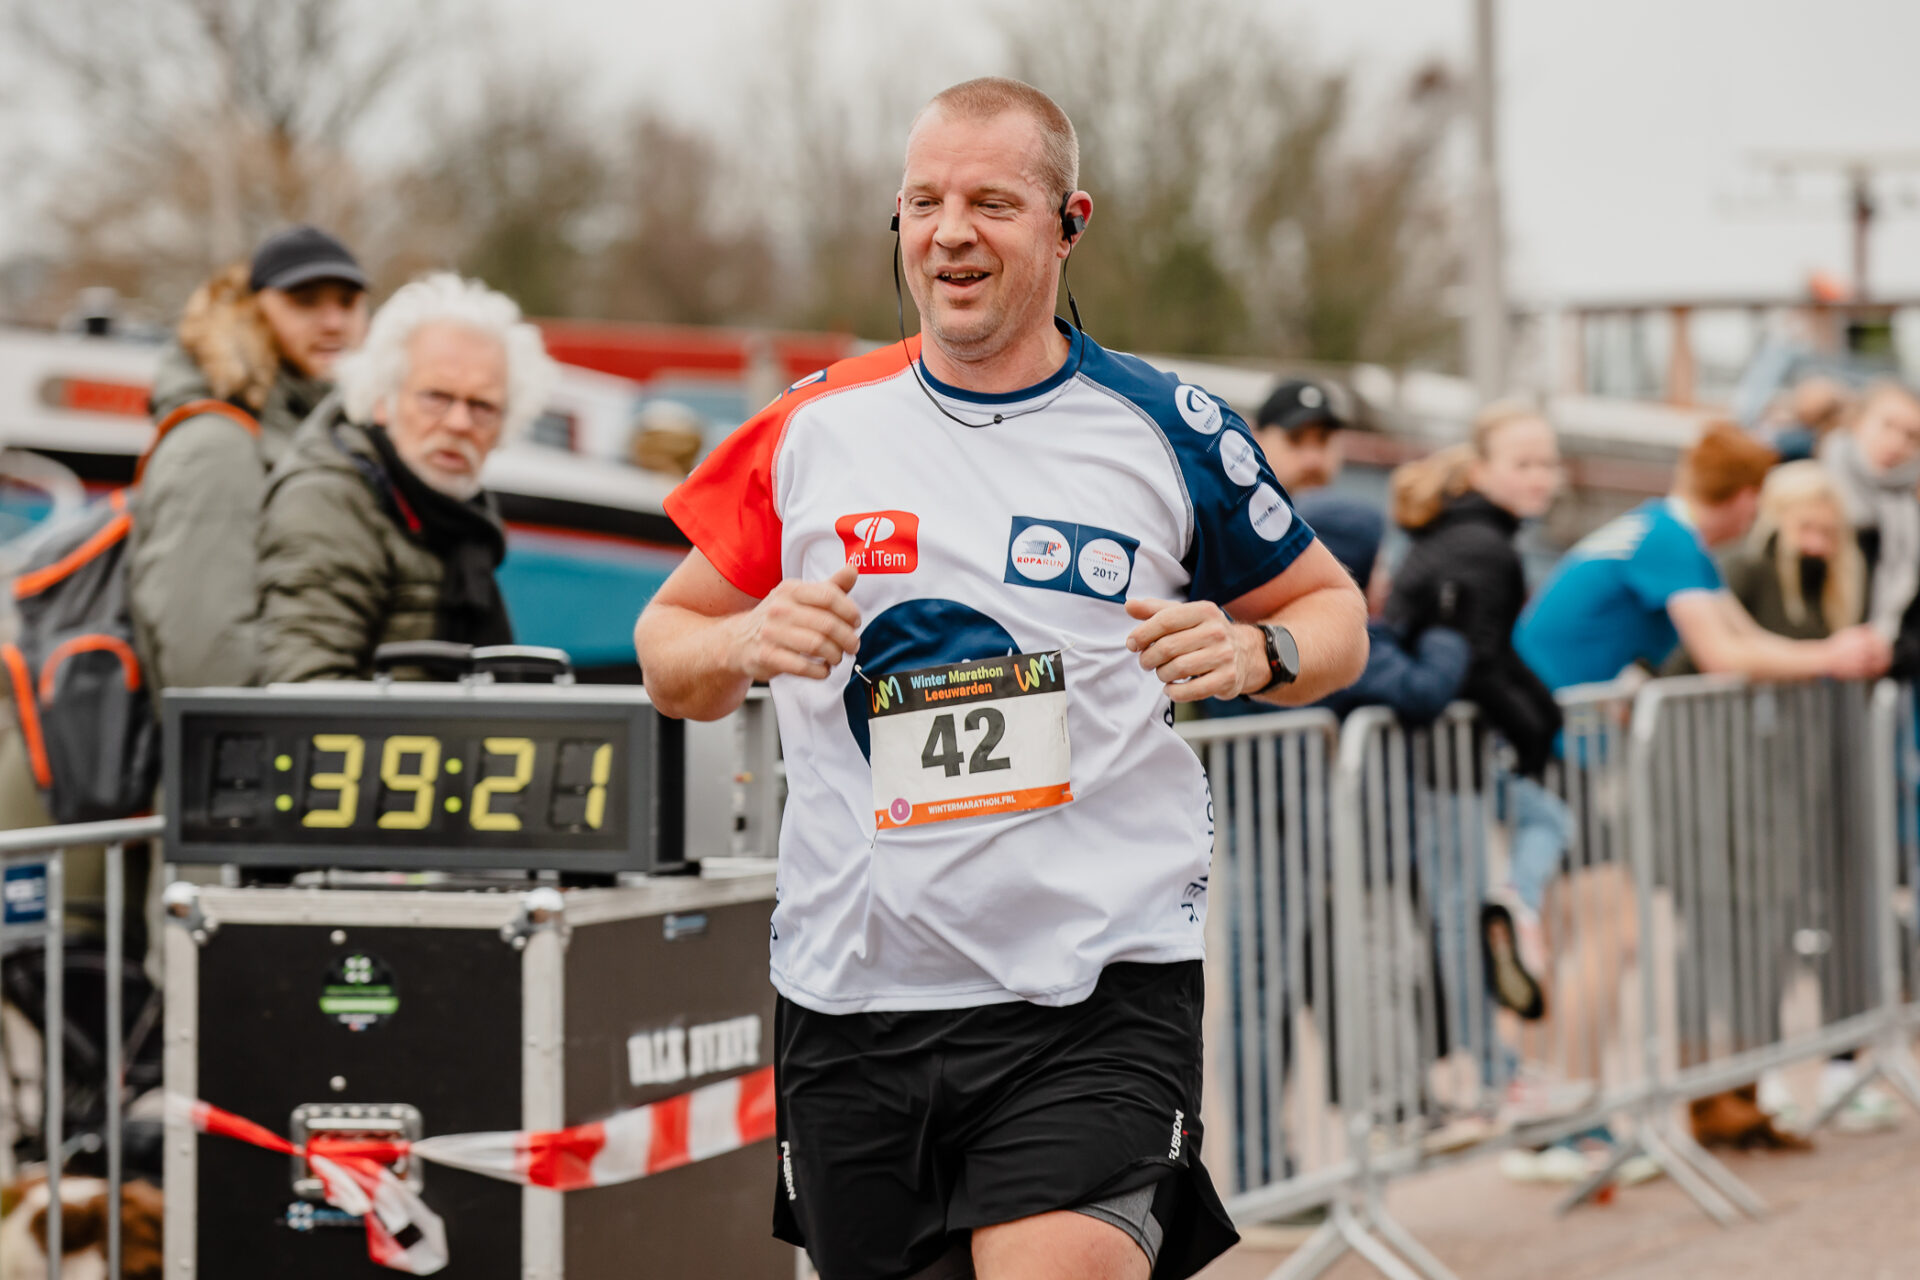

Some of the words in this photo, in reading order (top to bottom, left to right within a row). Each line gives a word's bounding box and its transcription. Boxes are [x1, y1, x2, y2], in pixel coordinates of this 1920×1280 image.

[1016, 556, 1064, 568] ROPARUN
[1093, 566, 1118, 581] 2017
[910, 674, 946, 689] Winter
[948, 666, 1004, 684] Marathon
[924, 682, 992, 702] Leeuwarden
[921, 707, 1011, 778] 42
[928, 795, 1016, 815] WINTERMARATHON.FRL
